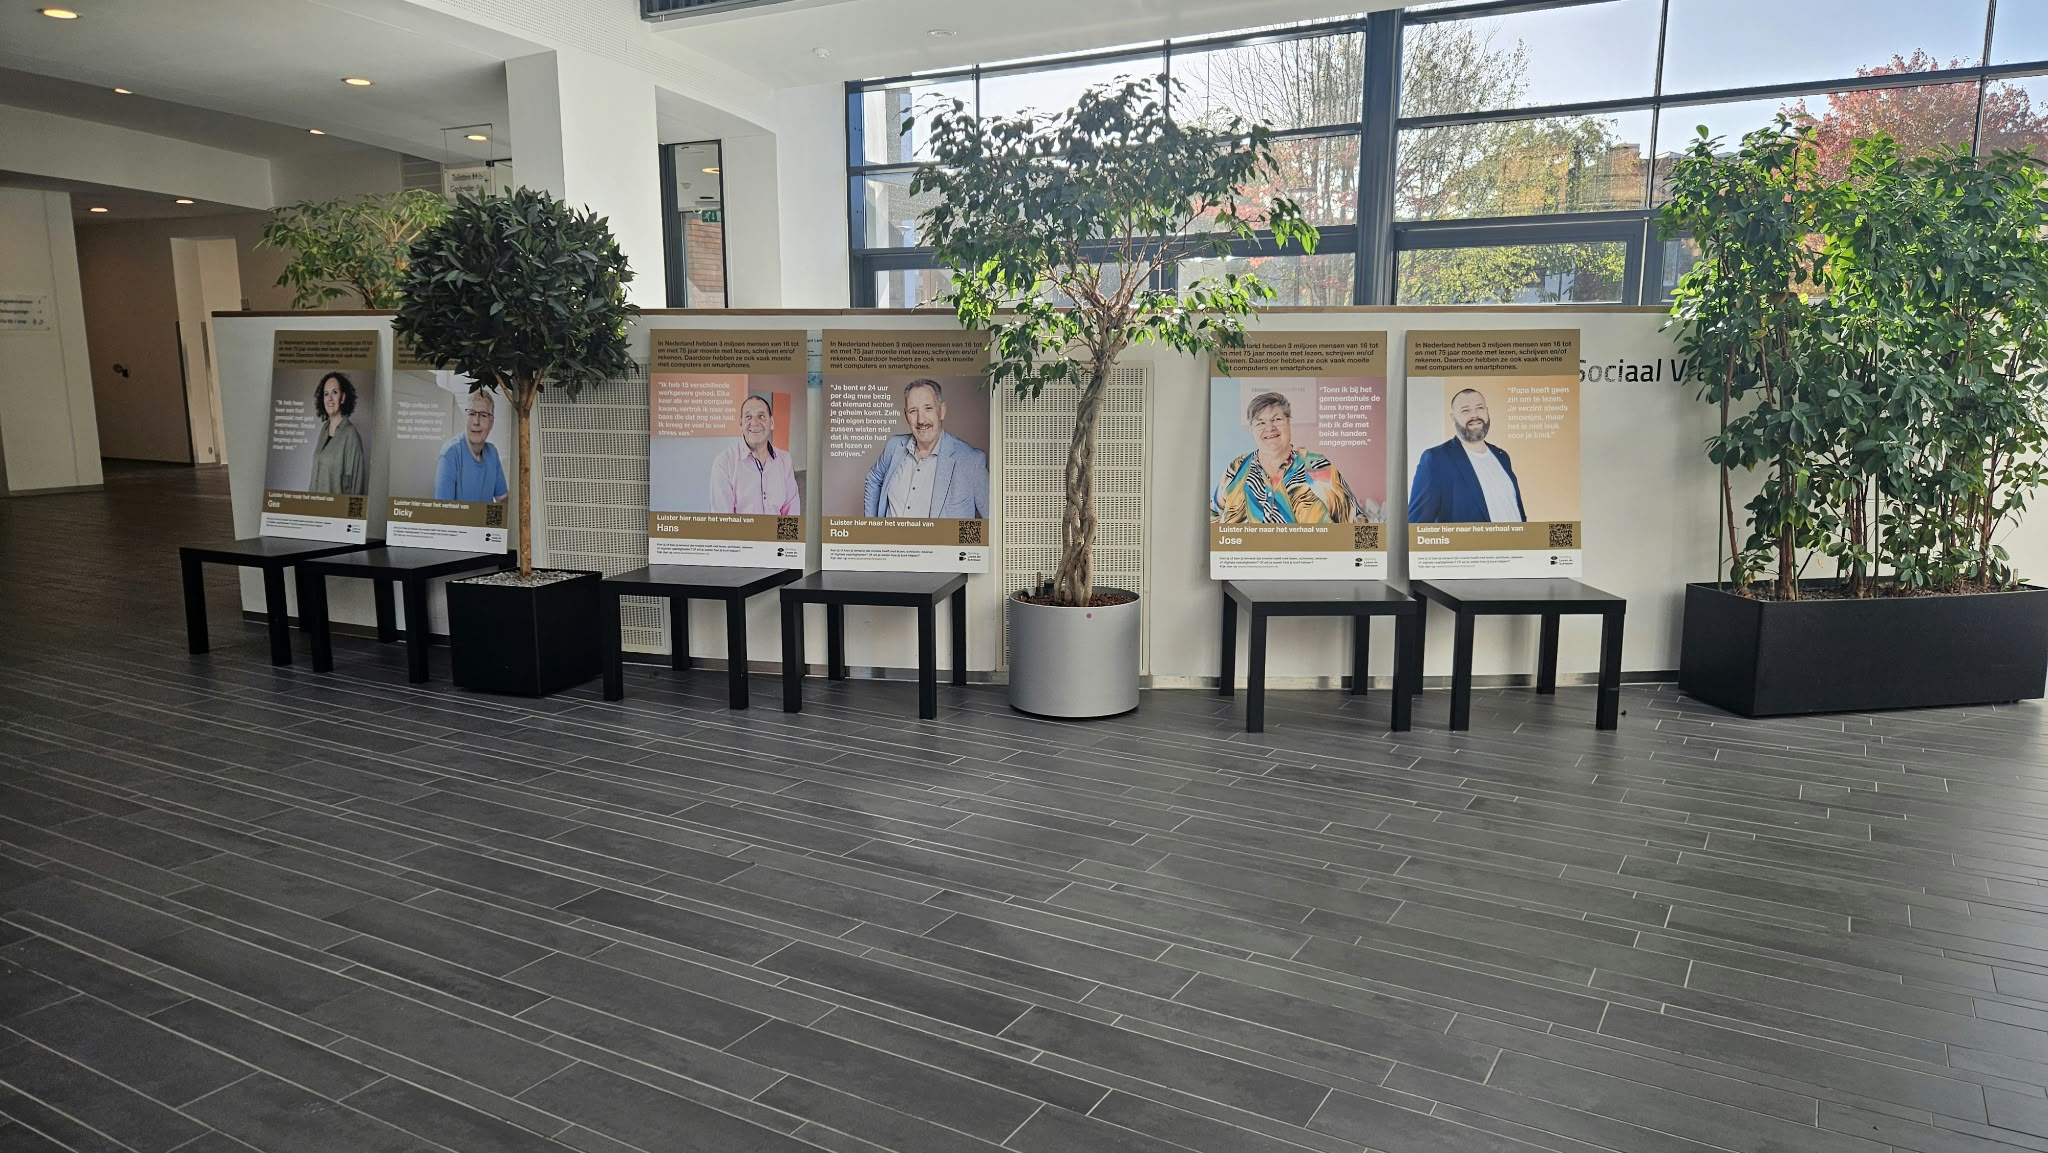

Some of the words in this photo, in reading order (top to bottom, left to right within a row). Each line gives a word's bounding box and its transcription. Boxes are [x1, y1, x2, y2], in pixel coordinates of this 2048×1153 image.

[1488, 341, 1512, 349] miljoen
[1447, 348, 1460, 356] jaar
[1499, 348, 1518, 356] lezen,
[1519, 348, 1549, 356] schrijven
[1474, 363, 1518, 371] smartphones.
[1350, 386, 1359, 394] bij
[843, 392, 856, 400] dag
[873, 392, 891, 400] bezig
[1320, 395, 1370, 403] gemeentehuis
[1339, 404, 1359, 412] kreeg
[830, 409, 836, 417] je
[838, 409, 862, 417] geheim
[831, 417, 845, 425] mijn
[846, 417, 864, 425] eigen
[1320, 439, 1371, 447] aangegrepen."
[831, 450, 865, 458] schrijven."
[719, 515, 742, 523] verhaal
[657, 524, 679, 532] Hans
[830, 529, 849, 537] Rob
[1219, 536, 1242, 544] Jose
[1417, 536, 1450, 544] Dennis
